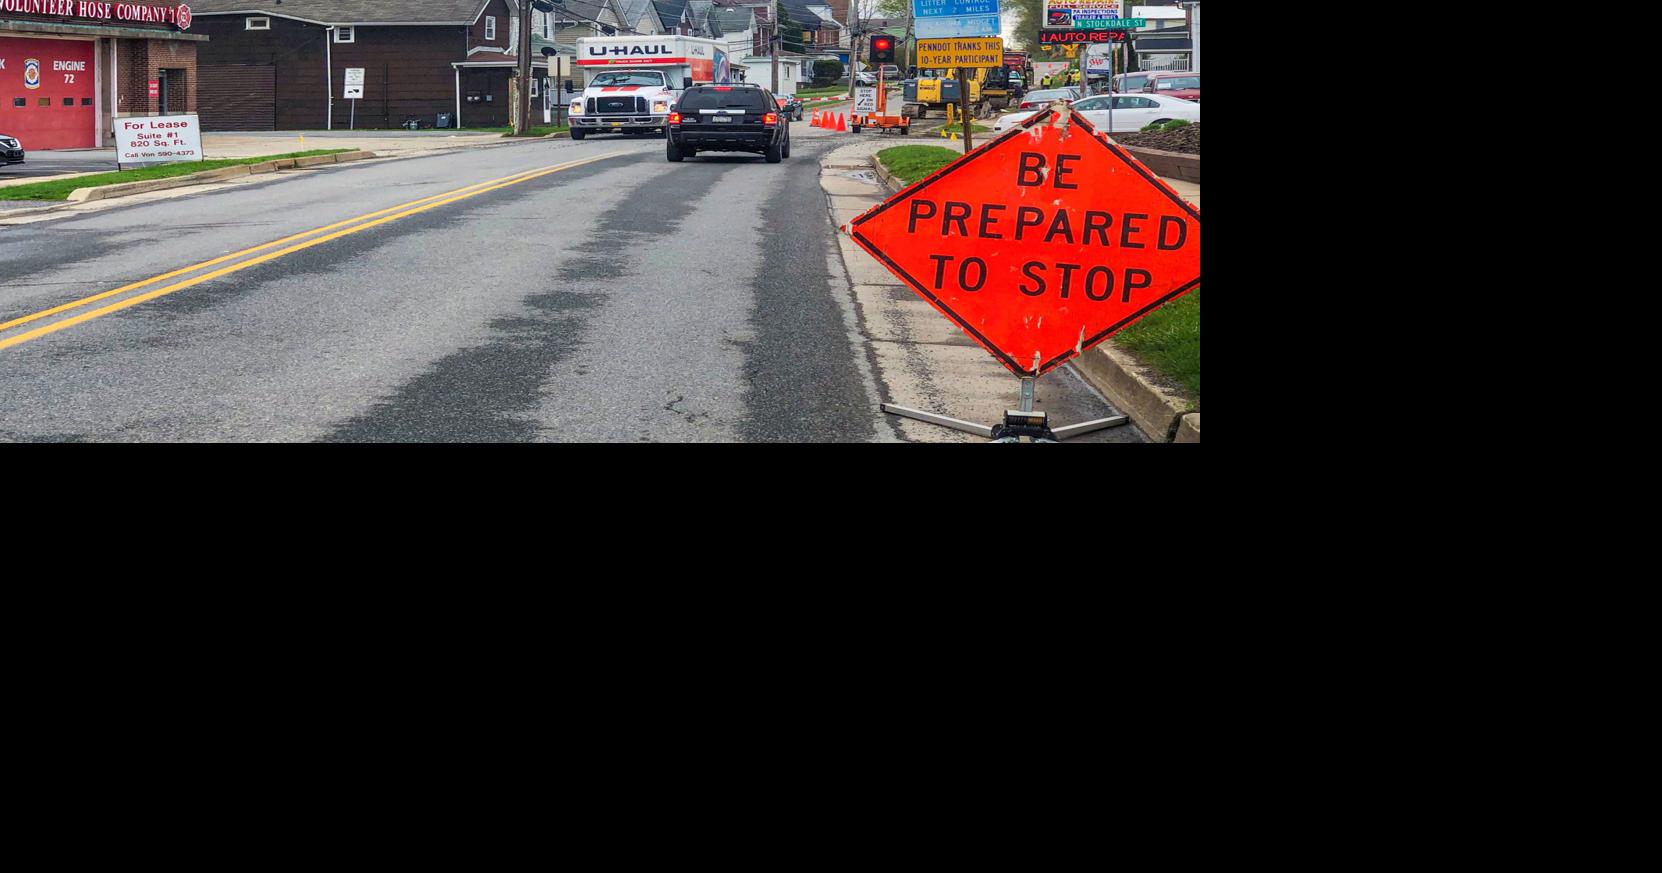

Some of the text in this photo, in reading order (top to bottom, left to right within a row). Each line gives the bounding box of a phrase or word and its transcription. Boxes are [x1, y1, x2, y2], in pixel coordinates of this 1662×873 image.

[79, 1, 111, 18] HOSE
[117, 4, 167, 23] COMPANY
[1086, 20, 1130, 28] STOCKDALE
[1049, 33, 1086, 41] AUTO
[919, 41, 1001, 51] PENNDOT THANKS THIS
[921, 54, 998, 64] 10-YEAR PARTICIPANT
[53, 61, 86, 71] ENGINE
[64, 74, 75, 84] 72
[124, 121, 188, 130] For Lease
[1017, 152, 1081, 189] BE
[907, 199, 1188, 250] PREPARED
[929, 254, 1152, 303] TO STOP
